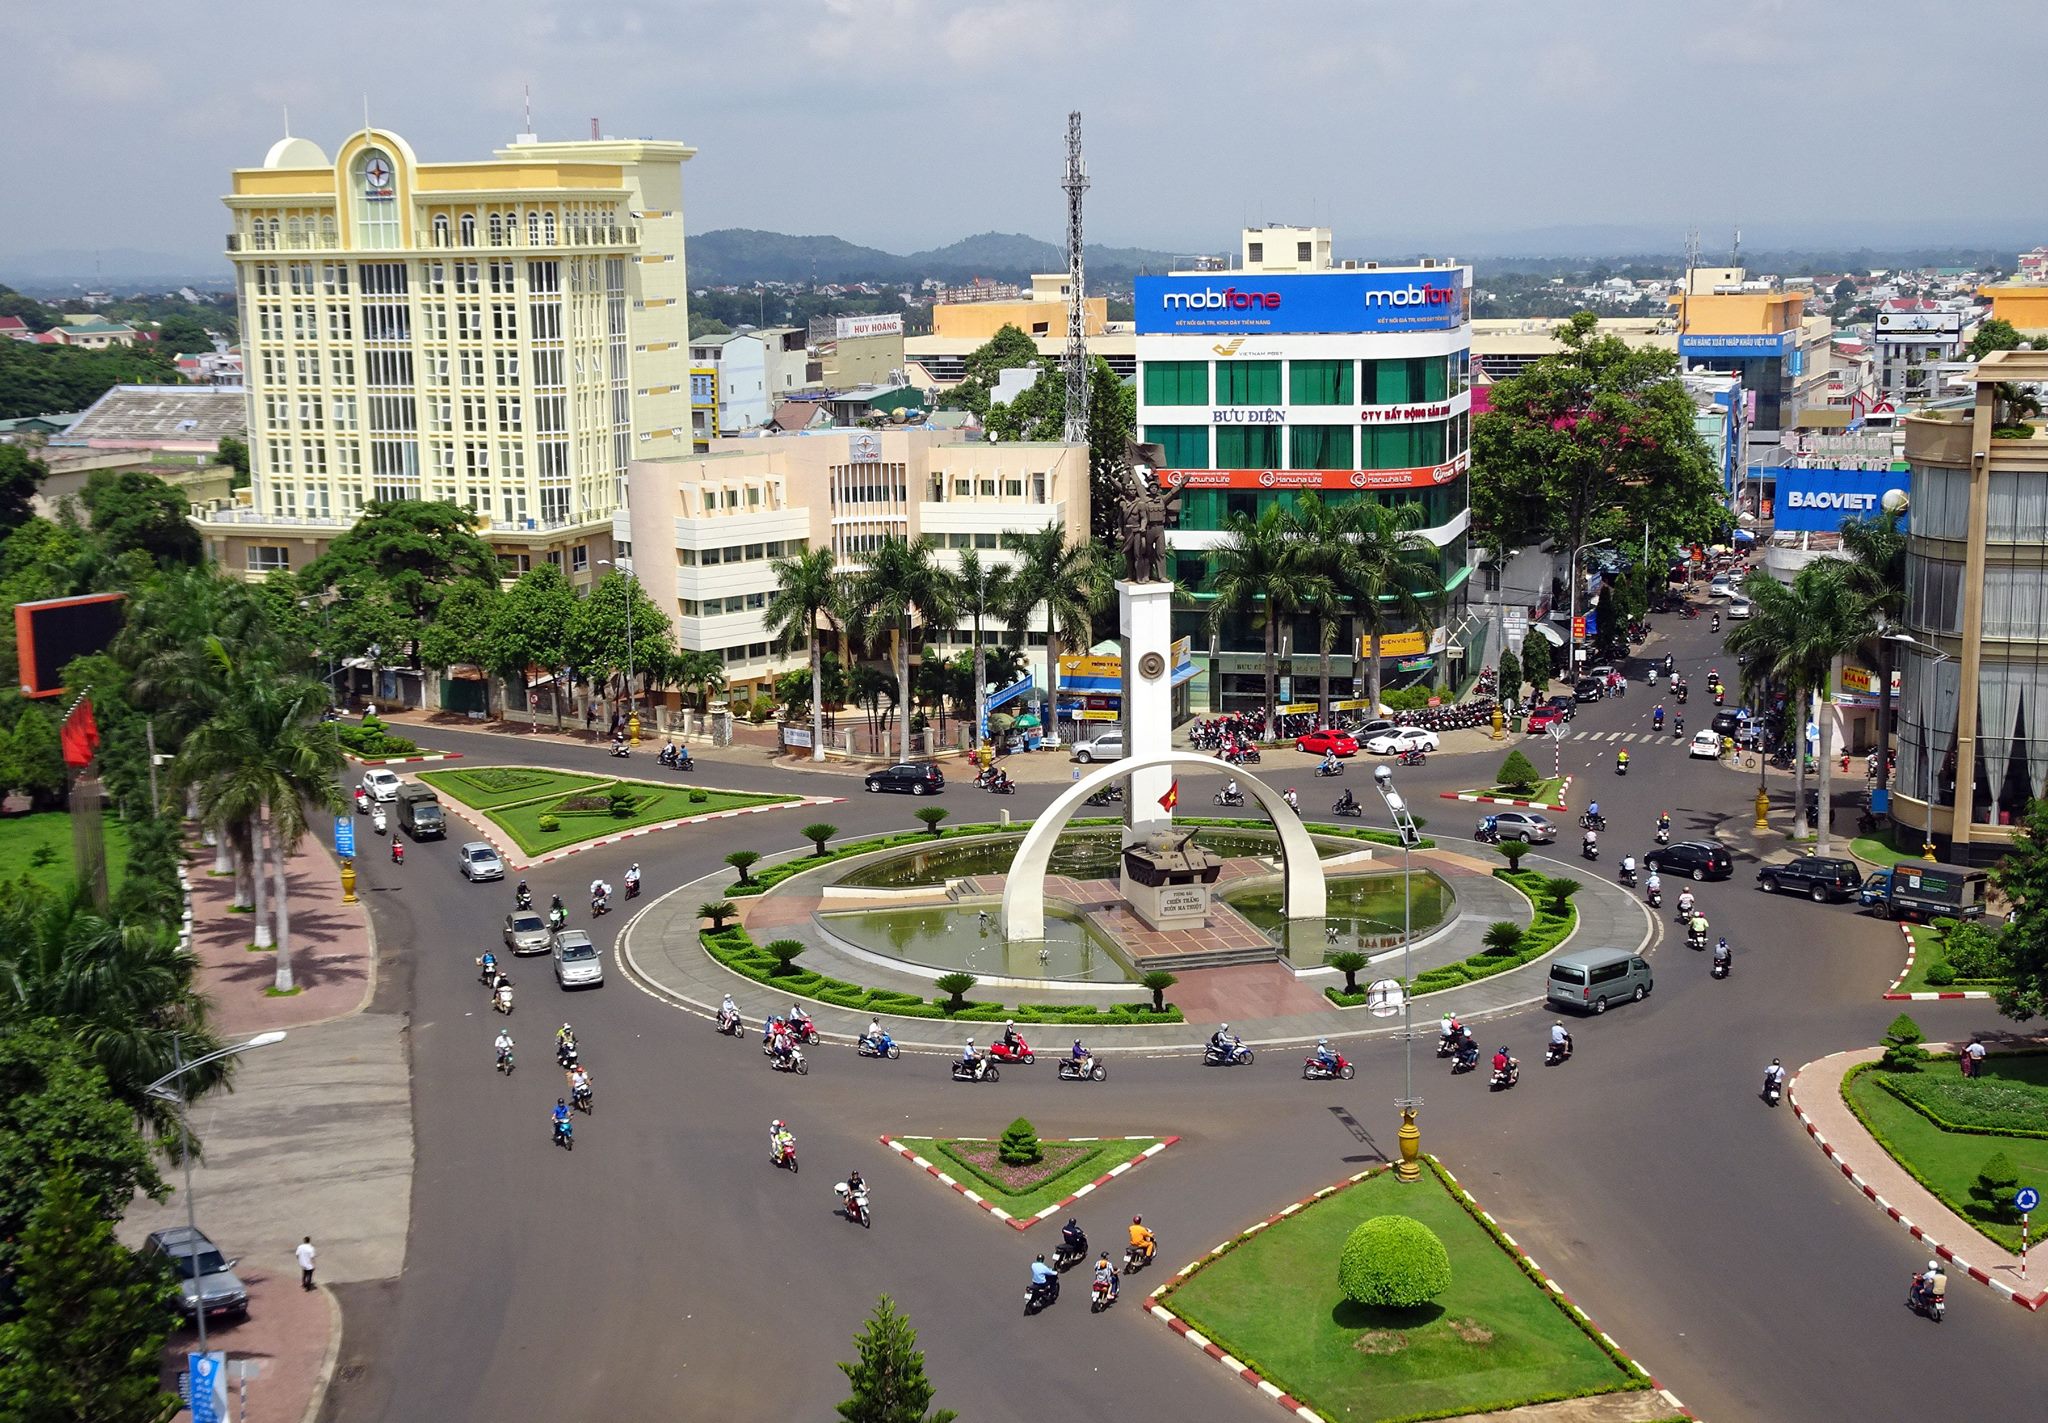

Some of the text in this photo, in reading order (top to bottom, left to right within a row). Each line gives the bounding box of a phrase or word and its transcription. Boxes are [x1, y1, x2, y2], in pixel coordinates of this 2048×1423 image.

[1163, 287, 1281, 308] mobifone
[854, 324, 869, 333] HUY
[1213, 408, 1286, 424] BƯU ĐIỆN
[1361, 411, 1381, 420] CTY
[1789, 491, 1877, 509] BAOVIET
